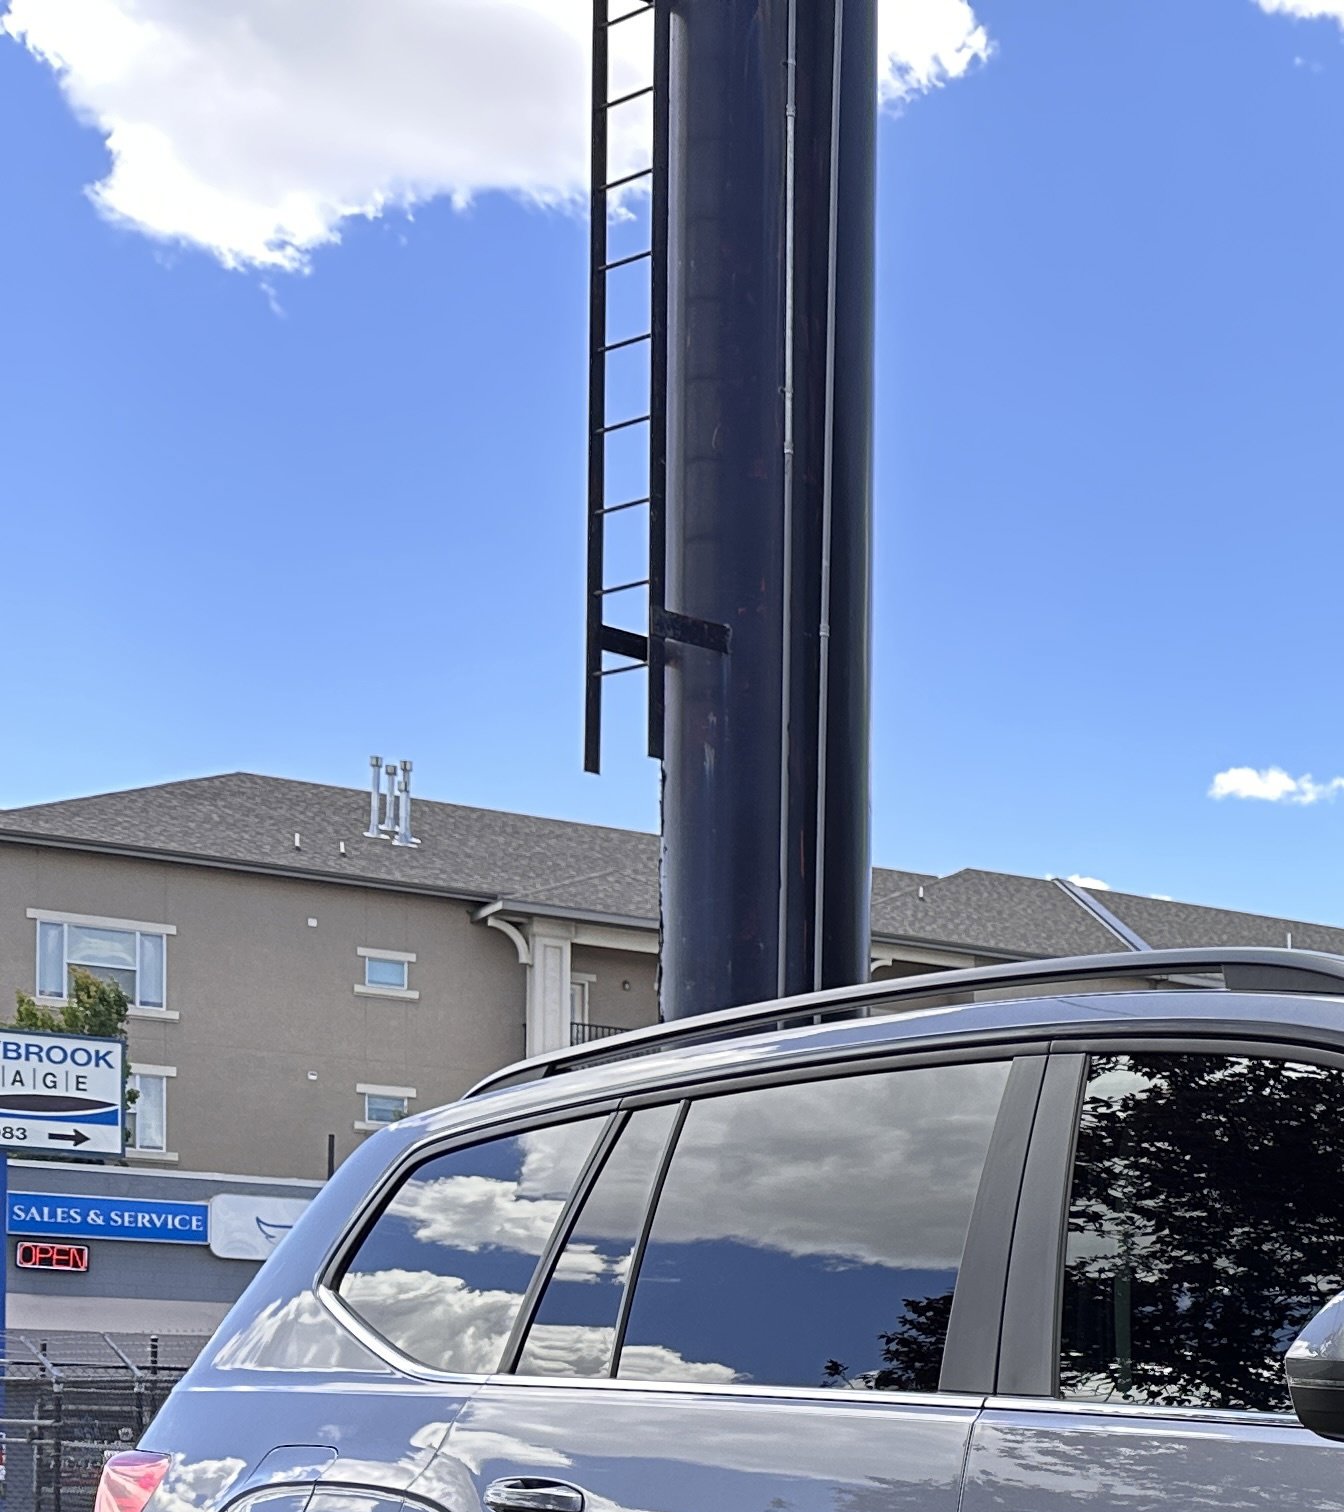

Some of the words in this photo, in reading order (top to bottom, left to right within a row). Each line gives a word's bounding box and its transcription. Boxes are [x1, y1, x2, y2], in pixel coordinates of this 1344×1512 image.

[0, 1041, 115, 1069] BROOK
[0, 1126, 28, 1141] 83
[12, 1204, 81, 1223] SALES
[87, 1208, 105, 1226] &
[110, 1210, 204, 1232] SERVICE
[18, 1243, 88, 1271] OPEN
